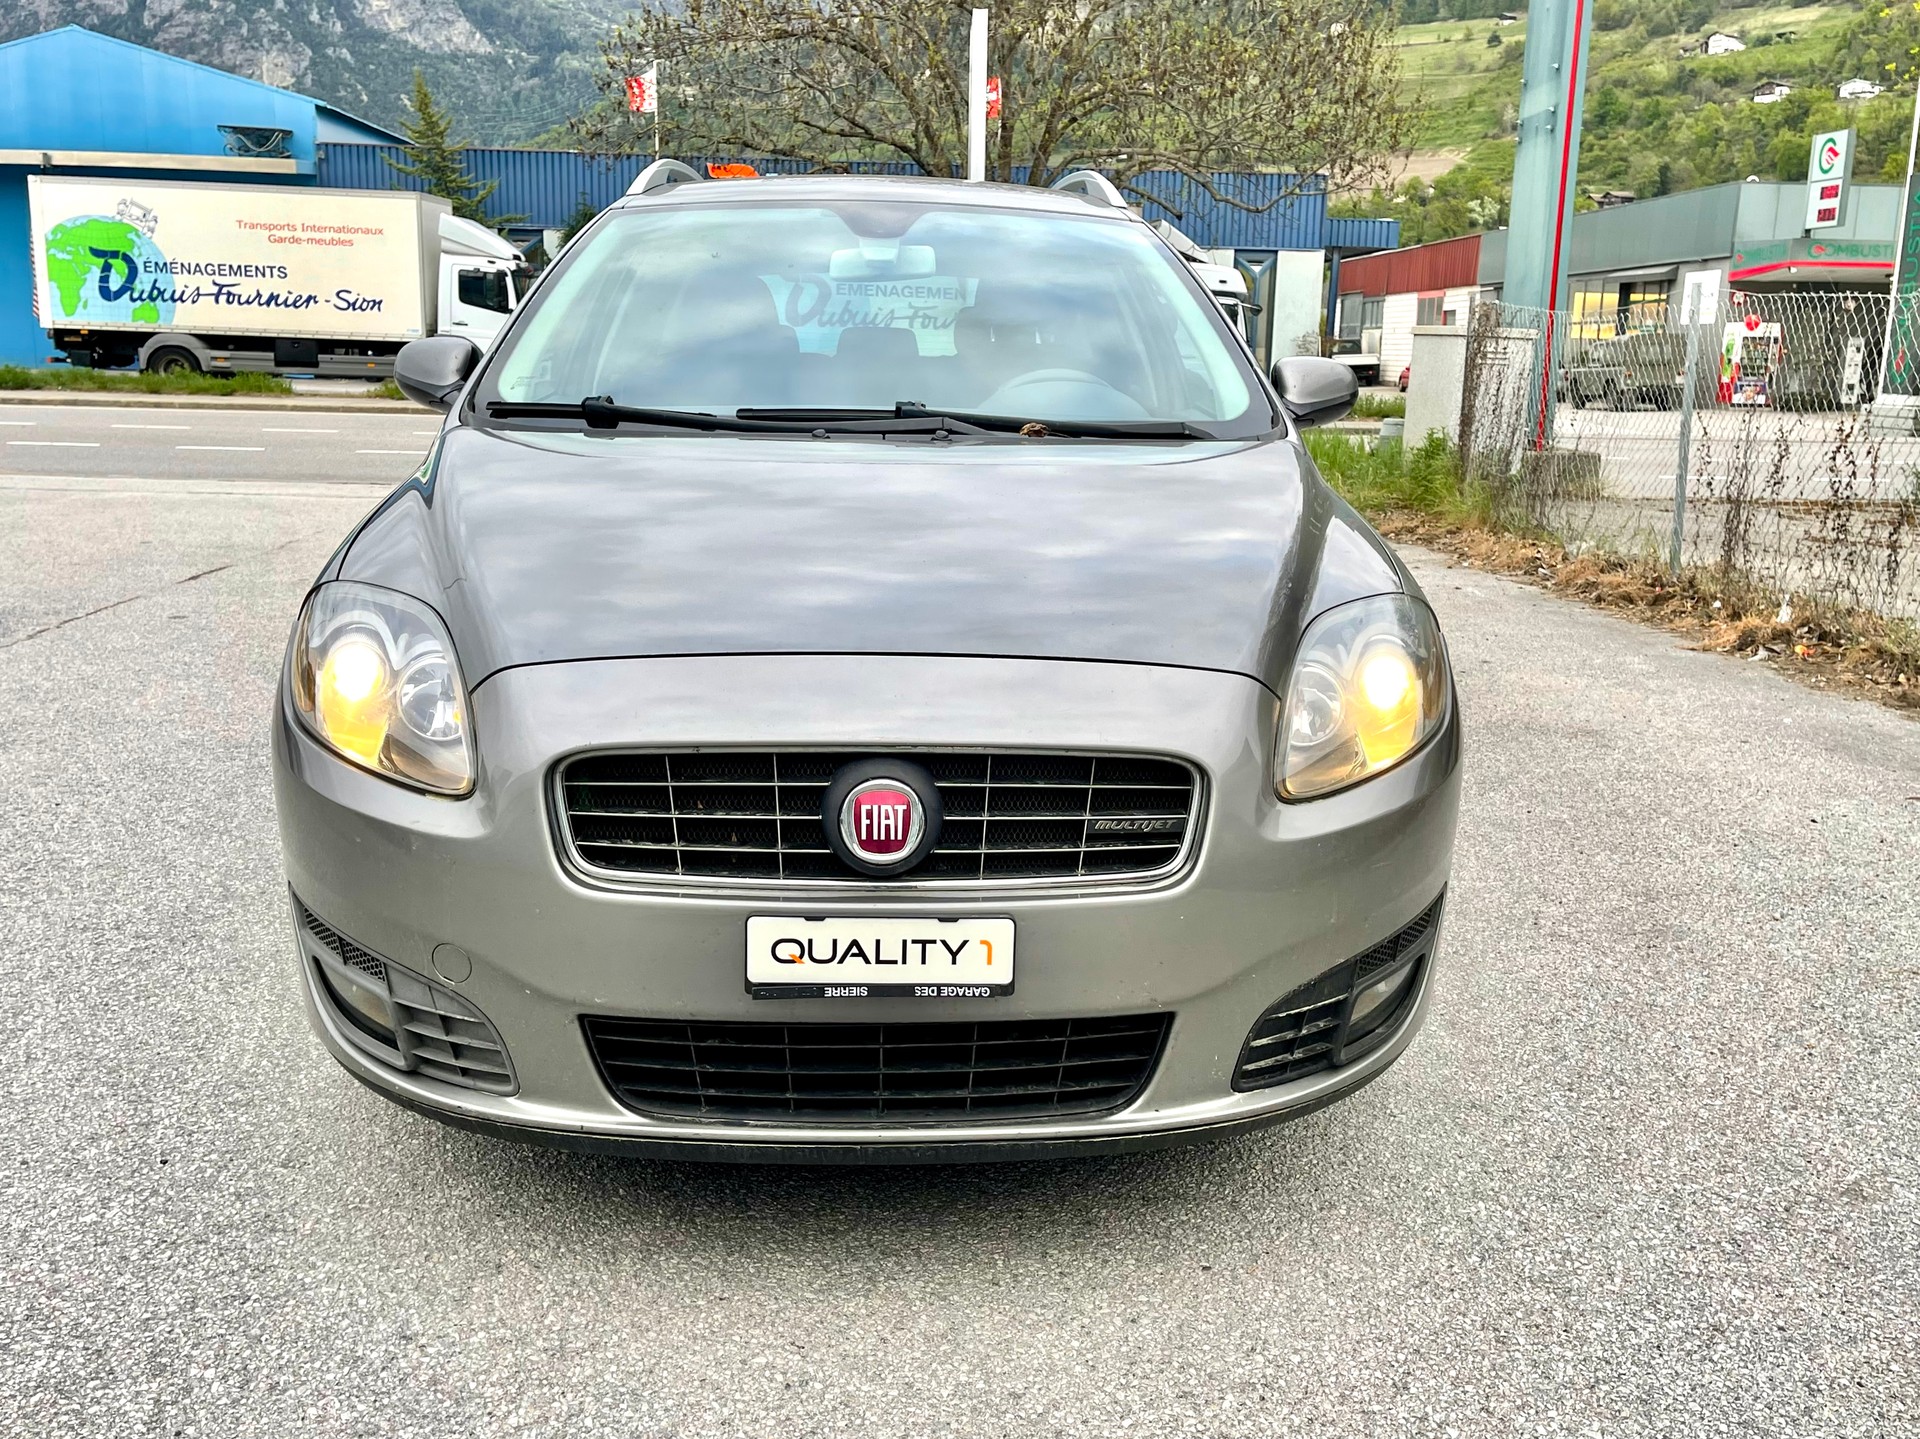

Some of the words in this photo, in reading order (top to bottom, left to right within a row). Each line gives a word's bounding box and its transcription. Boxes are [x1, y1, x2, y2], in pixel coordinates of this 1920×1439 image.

[235, 219, 297, 233] Transports
[301, 222, 384, 236] Internationaux
[267, 233, 354, 247] Garde-meubles
[333, 288, 384, 313] Sion
[860, 804, 908, 841] FIAT
[1094, 819, 1178, 832] MULTIJET
[770, 937, 970, 966] QUALITY
[979, 939, 993, 966] 1
[823, 986, 868, 997] SIERRE
[914, 986, 937, 997] DES
[940, 986, 991, 997] GARAGE
